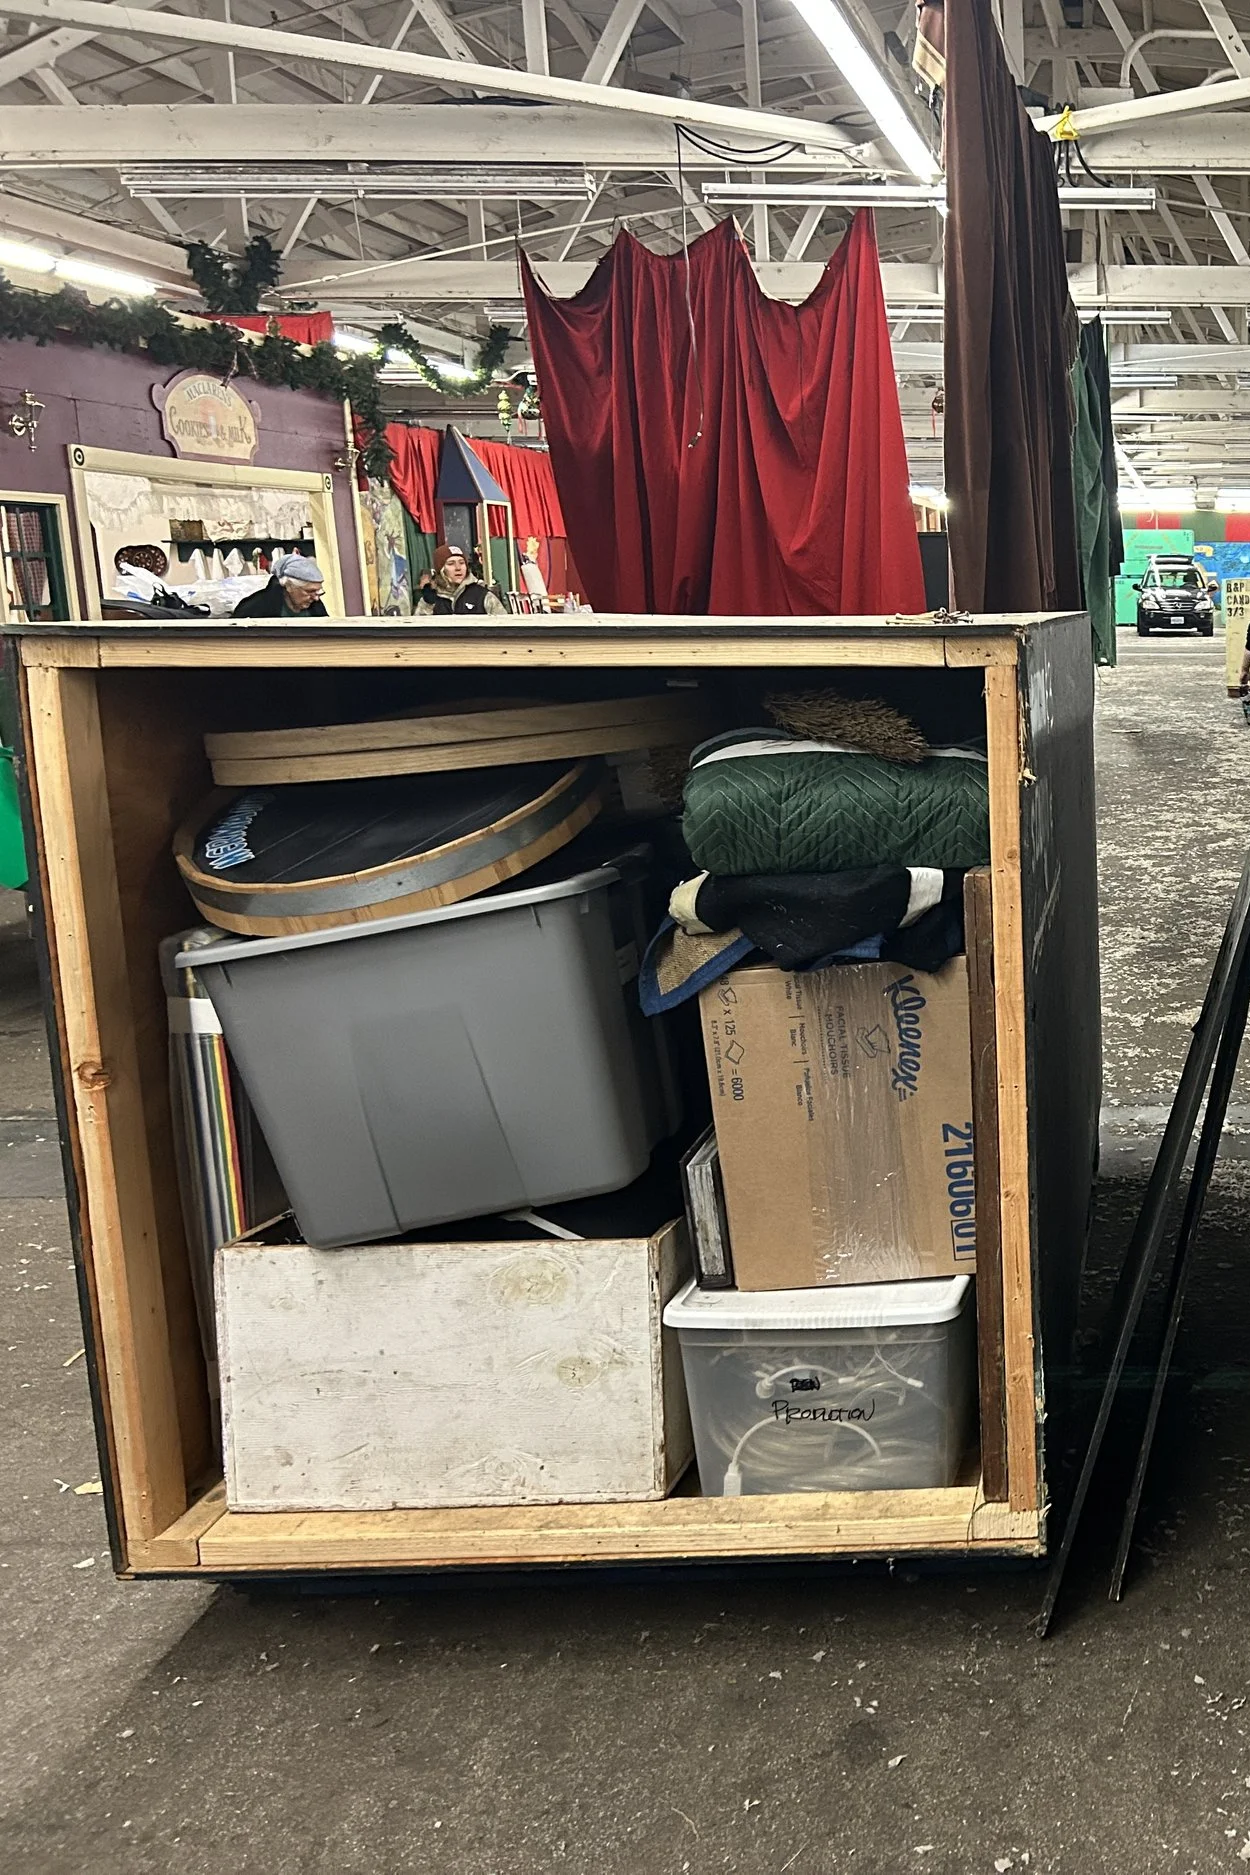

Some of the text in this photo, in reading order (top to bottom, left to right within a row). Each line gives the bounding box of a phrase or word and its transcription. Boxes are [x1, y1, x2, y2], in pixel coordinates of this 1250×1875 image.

[169, 405, 210, 438] COOKIES
[228, 415, 252, 444] MILK
[1226, 582, 1245, 593] B&P
[1227, 606, 1245, 617] 3/3
[785, 980, 793, 1000] White
[789, 1029, 797, 1047] Blanc
[800, 1022, 808, 1056] Mouchoirs
[825, 1013, 839, 1076] MOUCHOIRS
[835, 1005, 851, 1079] FACIAL TISSUE
[883, 974, 926, 1094] Kleenex
[724, 1019, 736, 1036] 125
[731, 1077, 745, 1101] 6000
